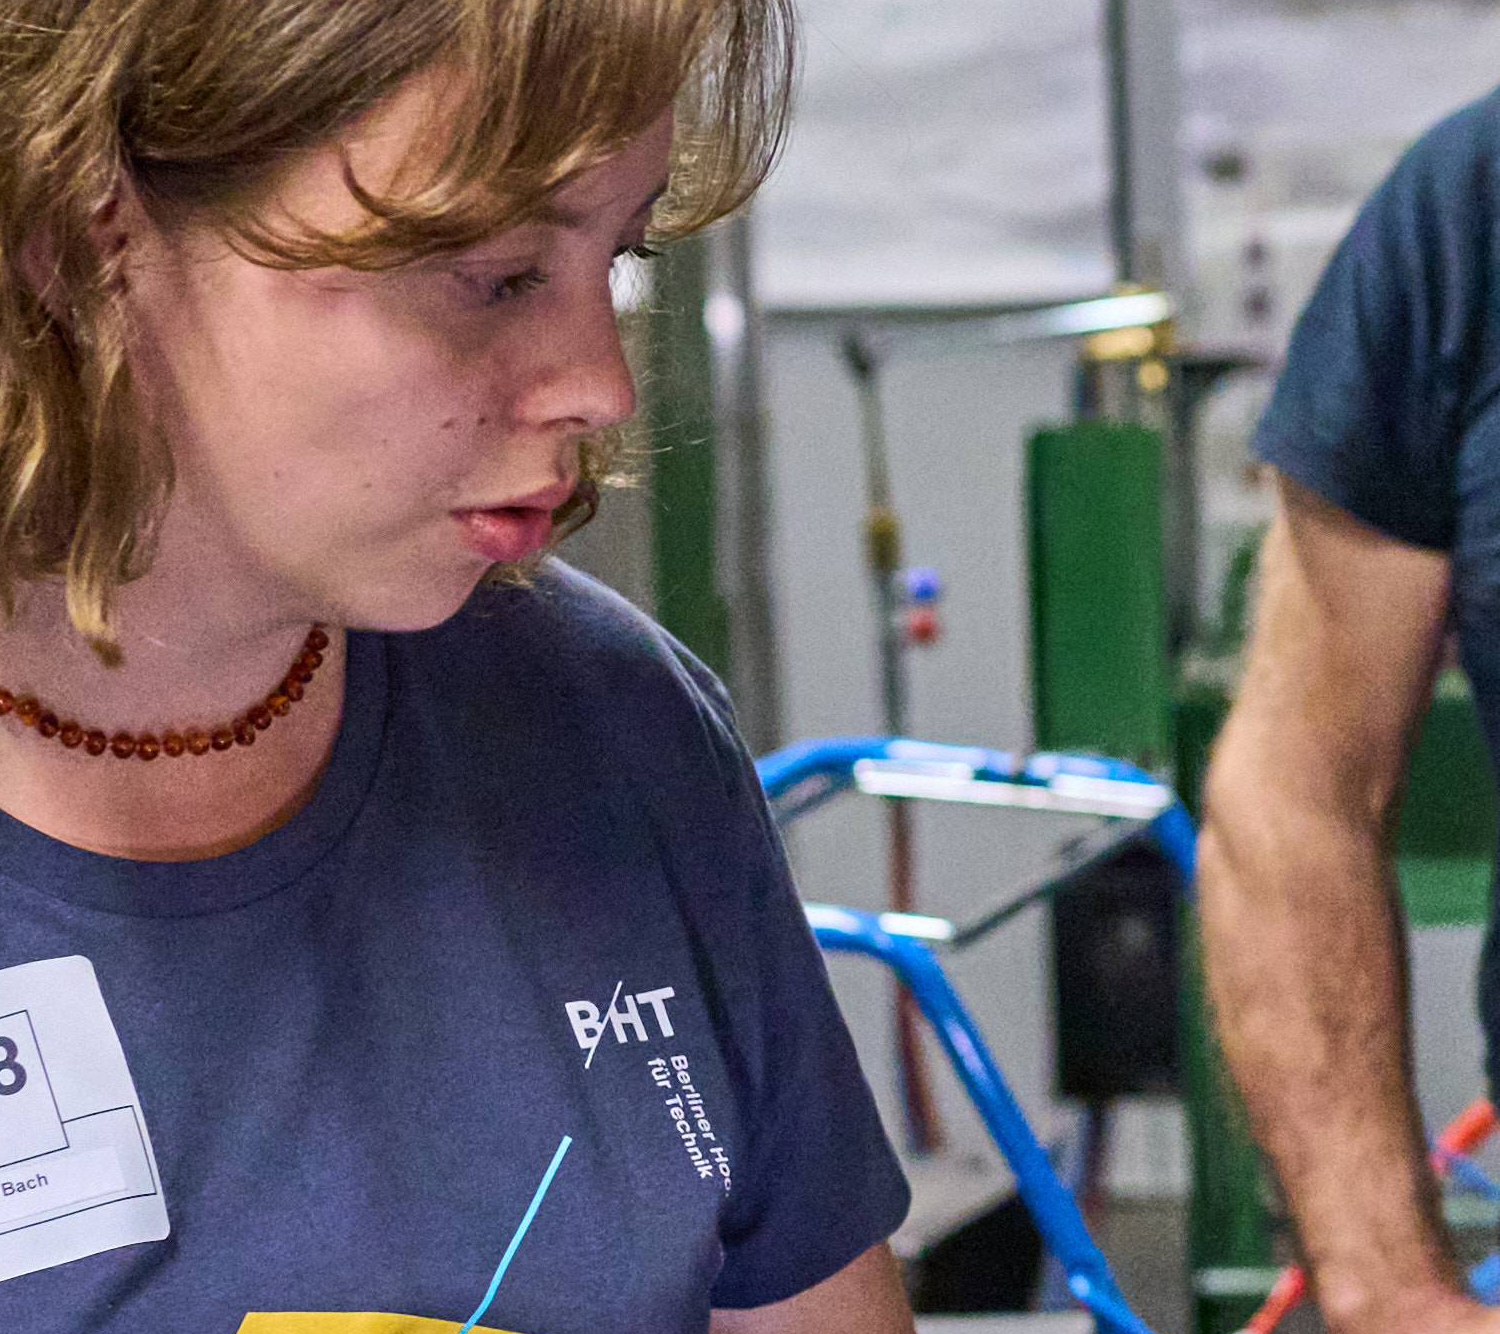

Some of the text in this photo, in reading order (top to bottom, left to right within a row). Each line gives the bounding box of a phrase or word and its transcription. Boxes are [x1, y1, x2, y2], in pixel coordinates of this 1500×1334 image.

[647, 1057, 713, 1179] für Technik
[670, 1054, 732, 1198] Berliner Hoc
[1, 1173, 49, 1197] Bach
